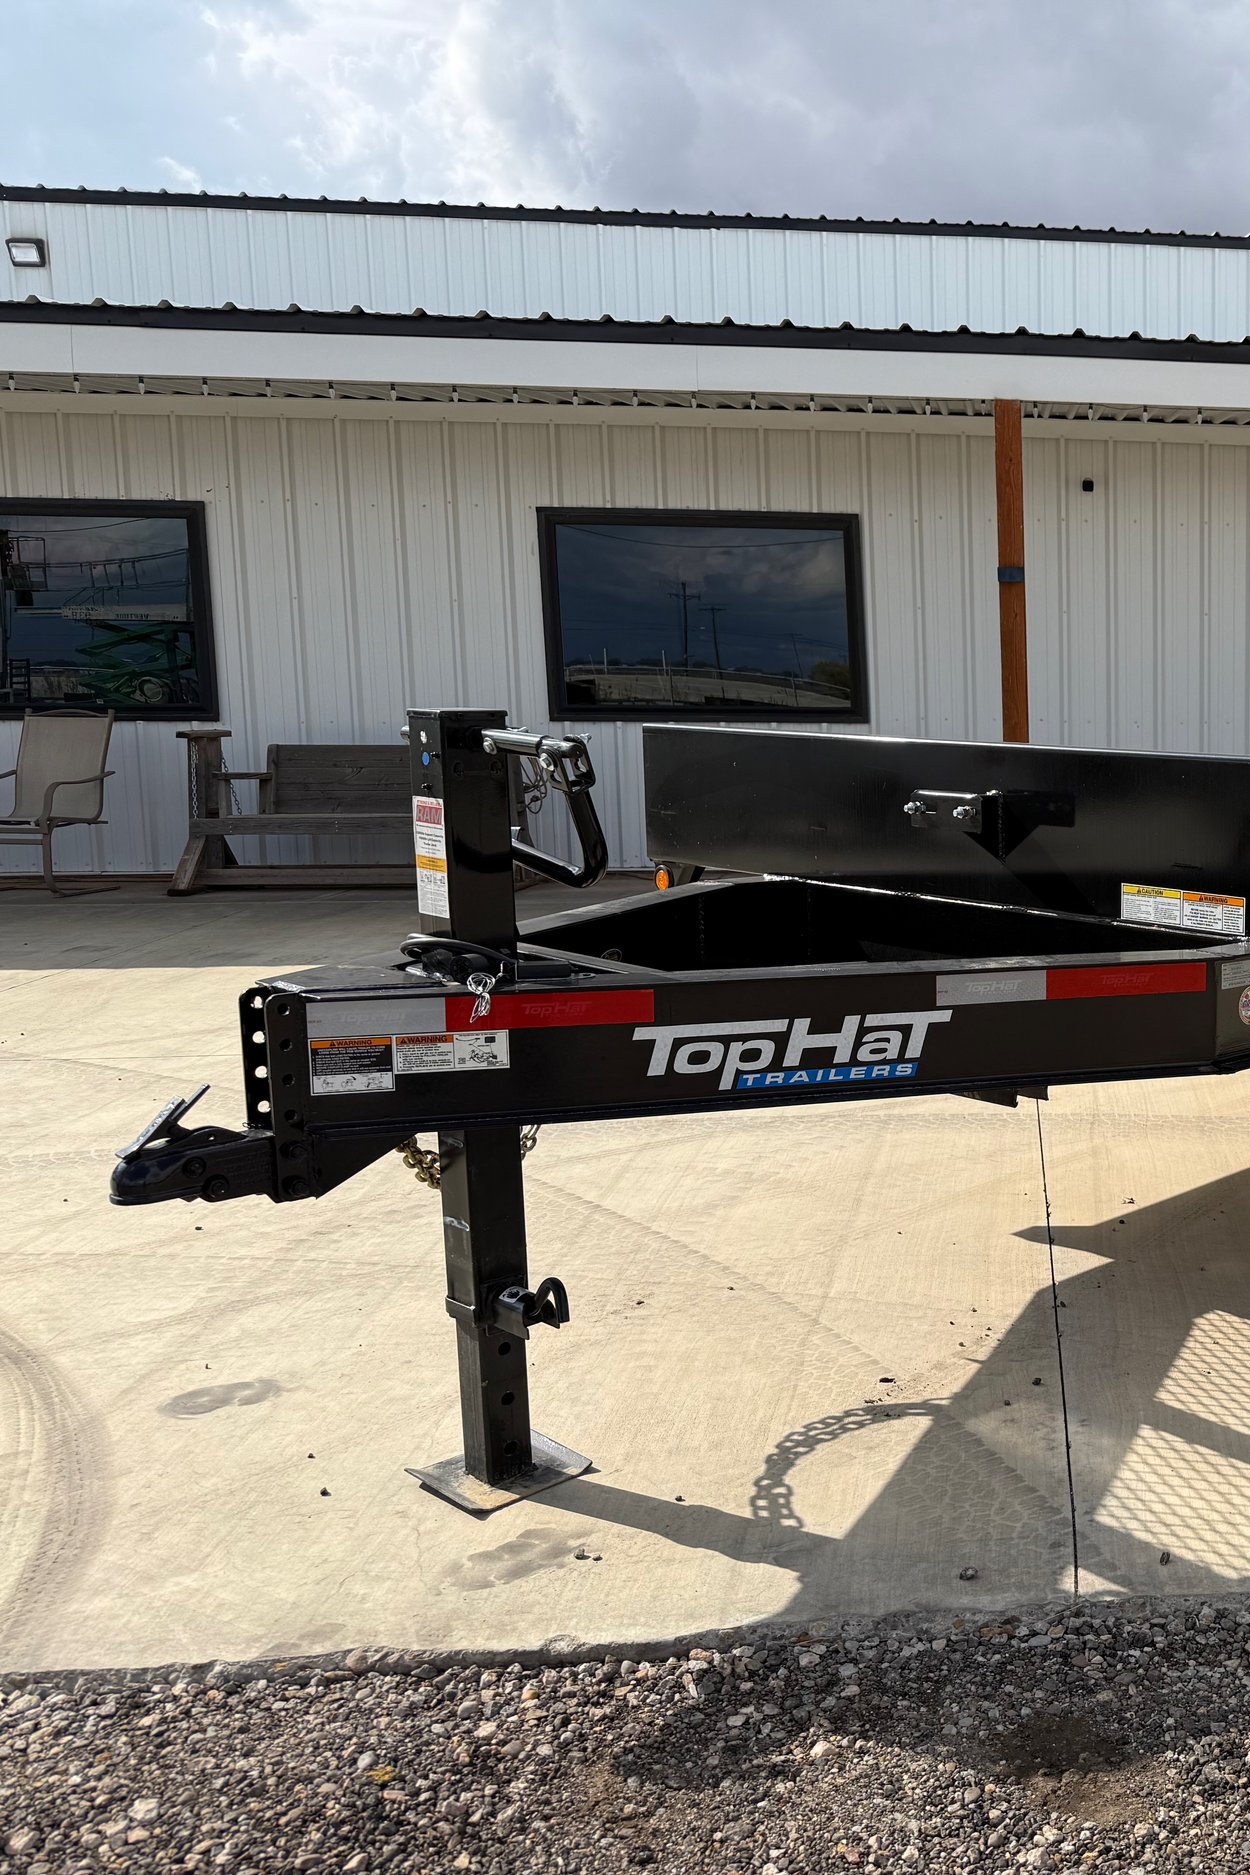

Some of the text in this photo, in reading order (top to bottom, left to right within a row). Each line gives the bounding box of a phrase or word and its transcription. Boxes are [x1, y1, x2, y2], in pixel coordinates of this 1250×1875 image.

[1141, 888, 1164, 896] CAUTION
[337, 1039, 373, 1047] WARNING
[407, 1034, 448, 1045] WARNING
[741, 1063, 914, 1087] TRAILERS
